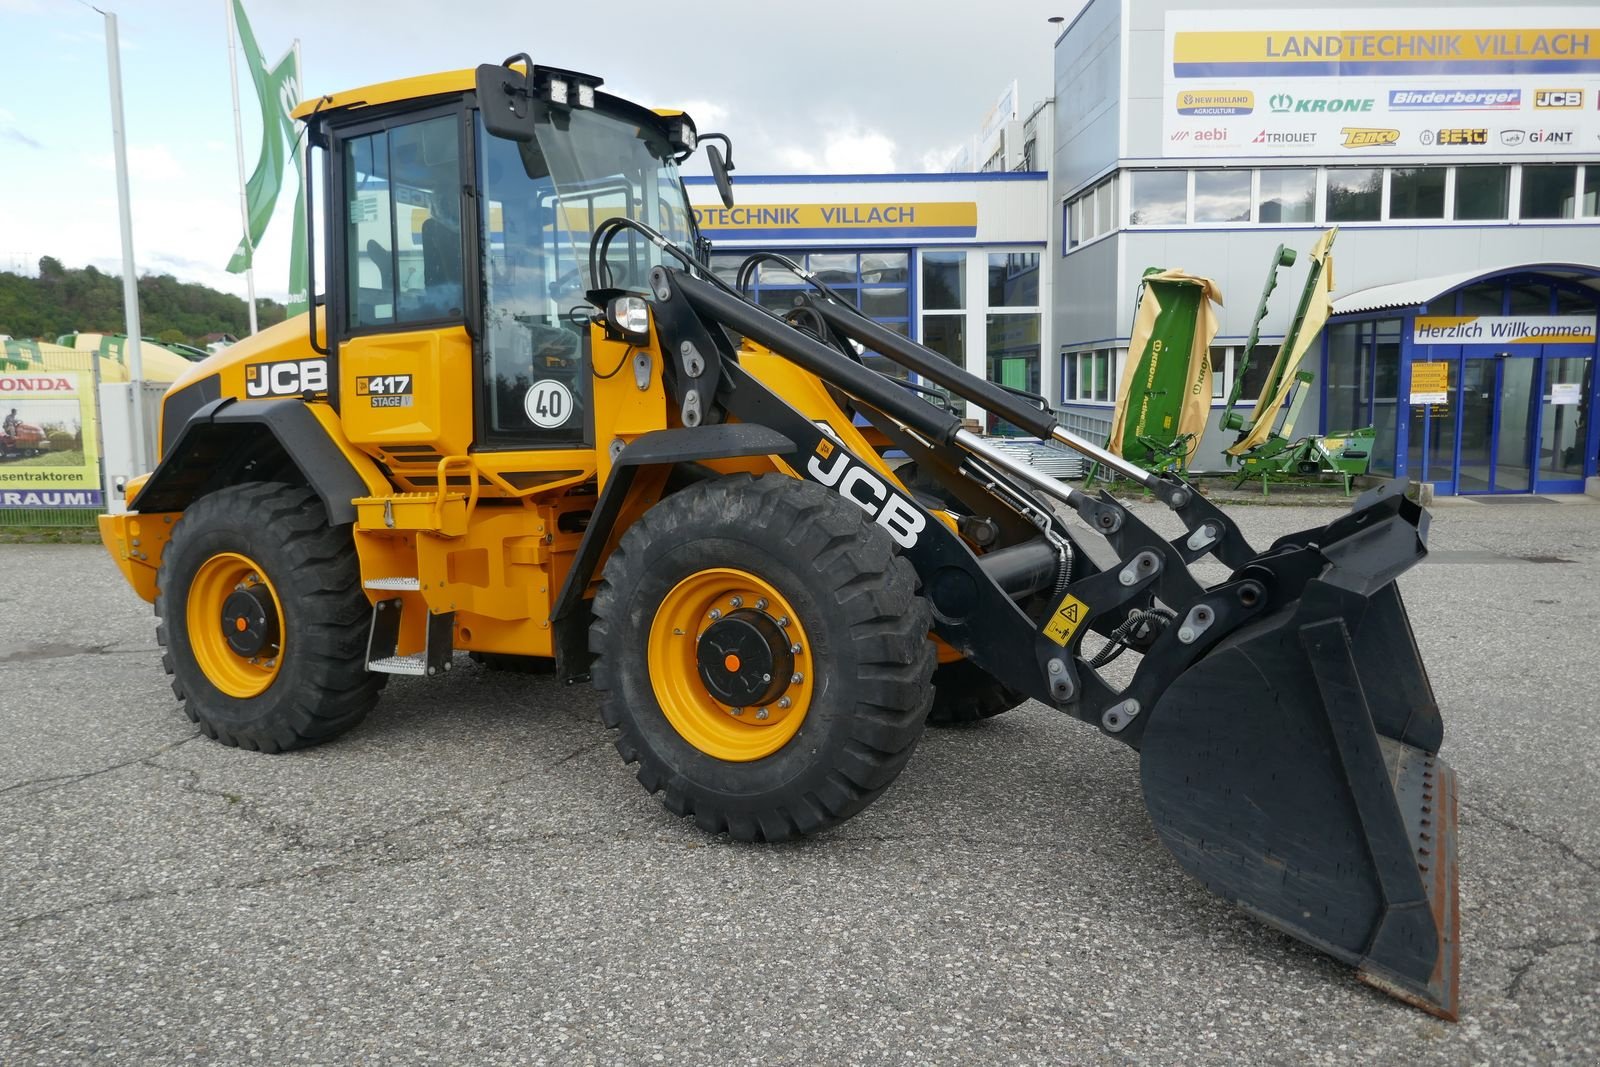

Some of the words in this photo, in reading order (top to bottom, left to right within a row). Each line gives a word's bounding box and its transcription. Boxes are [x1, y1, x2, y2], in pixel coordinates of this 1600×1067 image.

[1266, 34, 1463, 58] LANDTECHNIK
[1474, 33, 1590, 56] VILLACH
[1194, 96, 1212, 104] NEW
[1213, 96, 1248, 104] HOLLAND
[1294, 98, 1375, 113] KRONE
[1392, 91, 1519, 105] Binderberger
[1536, 91, 1581, 107] JCB
[1193, 107, 1236, 115] AGRICULTURE
[1194, 127, 1228, 141] aebi
[1340, 127, 1401, 149] Tanco
[820, 206, 915, 224] VILLACH
[1418, 321, 1483, 338] Herzlich
[1490, 321, 1592, 337] Willkommen
[246, 359, 328, 397] JCB
[369, 375, 410, 394] 417
[371, 396, 401, 408] STAGE
[535, 389, 562, 418] 40
[0, 471, 84, 481] sentraktoren
[807, 452, 927, 549] JCB
